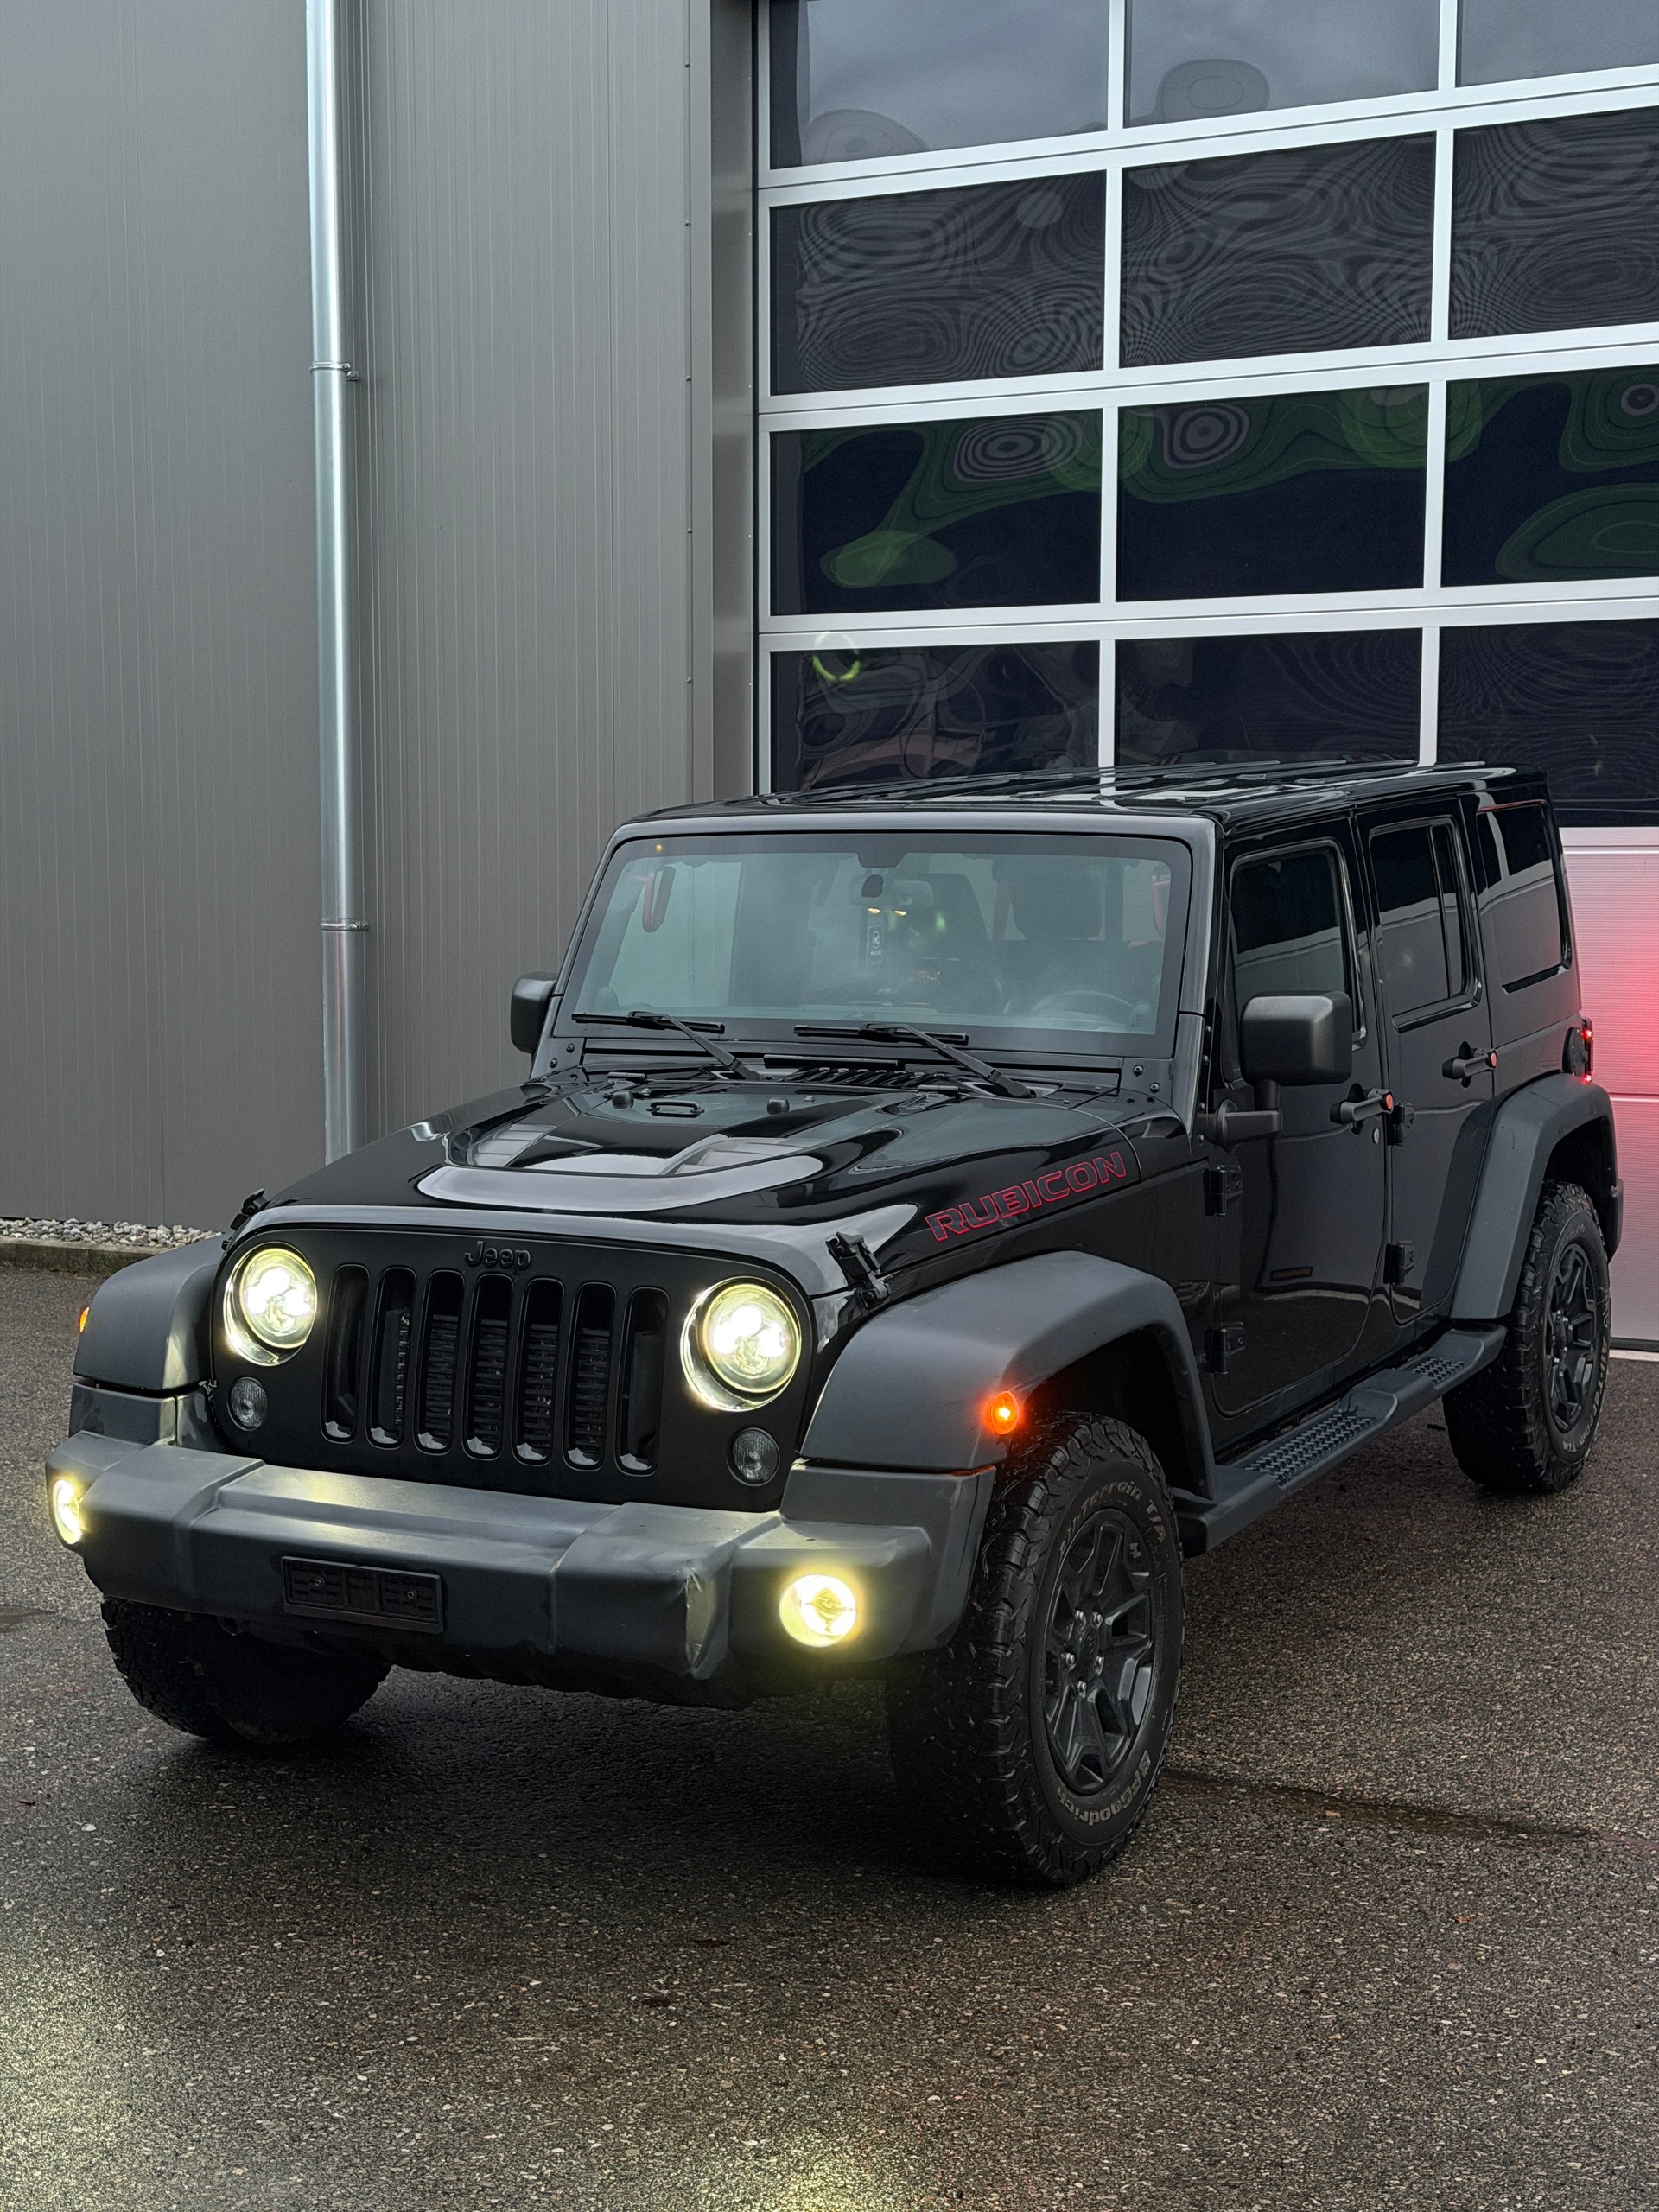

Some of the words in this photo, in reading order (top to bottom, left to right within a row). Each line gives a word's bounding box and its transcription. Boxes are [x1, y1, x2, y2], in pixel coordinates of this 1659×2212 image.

[925, 1151, 1127, 1242] RUBICON
[464, 1240, 531, 1275] Jeep
[1057, 1750, 1152, 1826] BFGoodrich
